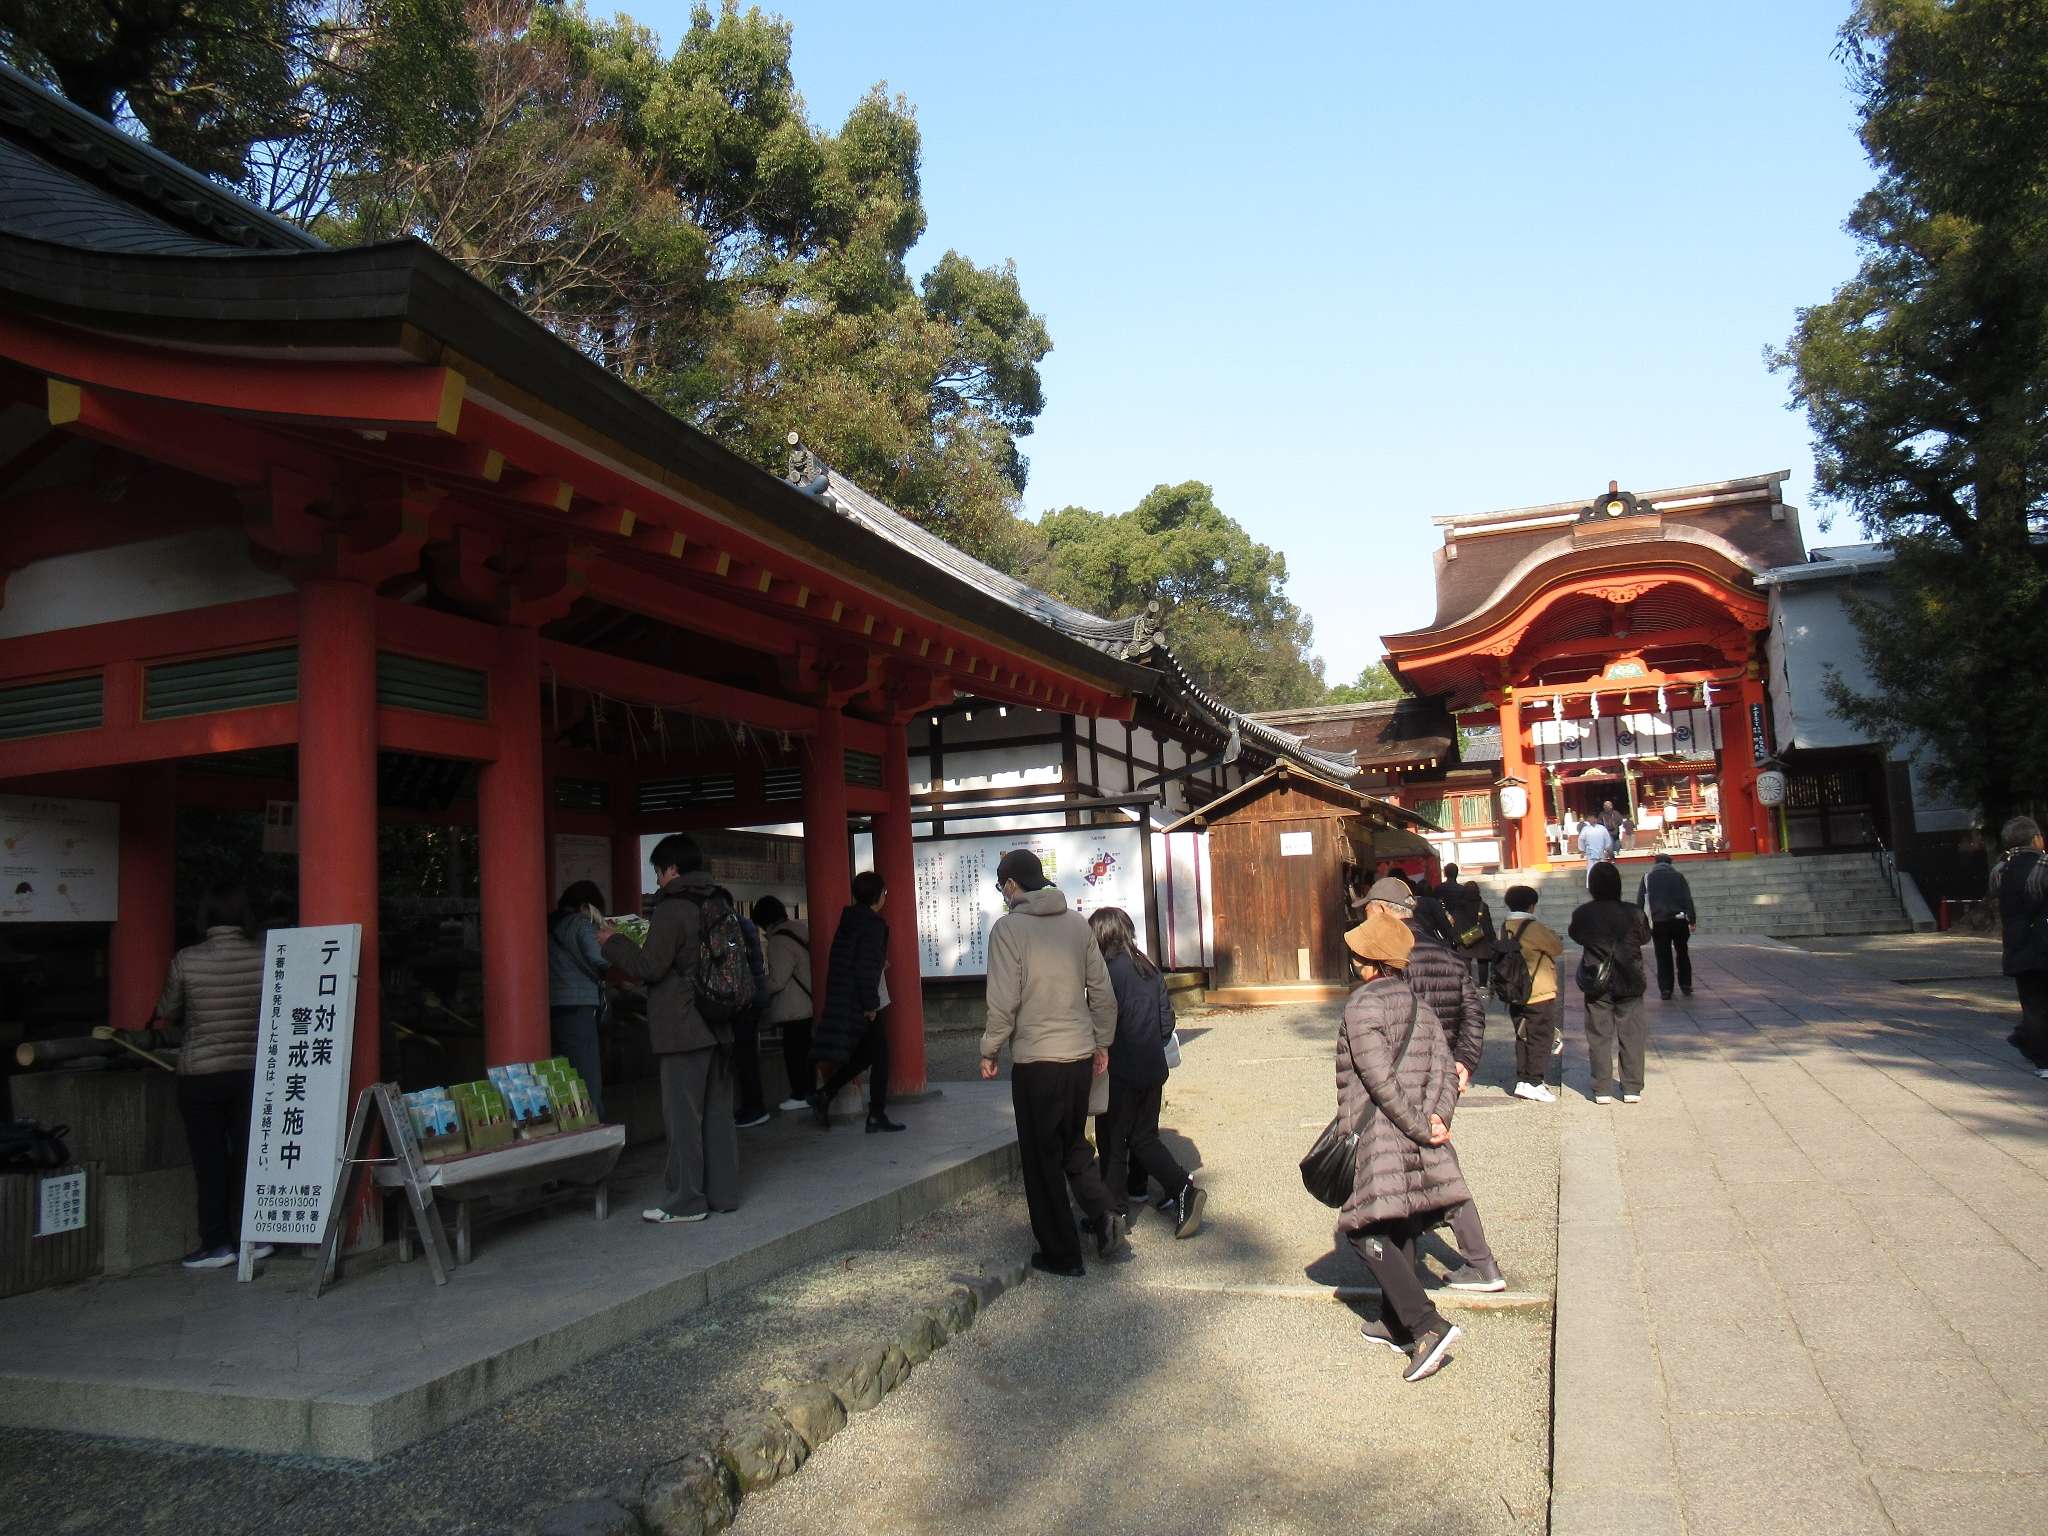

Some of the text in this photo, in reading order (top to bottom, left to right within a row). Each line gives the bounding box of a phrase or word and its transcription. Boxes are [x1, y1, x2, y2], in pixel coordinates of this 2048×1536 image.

[311, 940, 340, 1066] テロ対策
[279, 1007, 312, 1170] 警戒実施中
[256, 1184, 322, 1196] 石清水八幡宮
[258, 1197, 319, 1208] 075(981)3001
[254, 1209, 319, 1221] 八幡警察署
[255, 1222, 316, 1233] 075(981)0110
